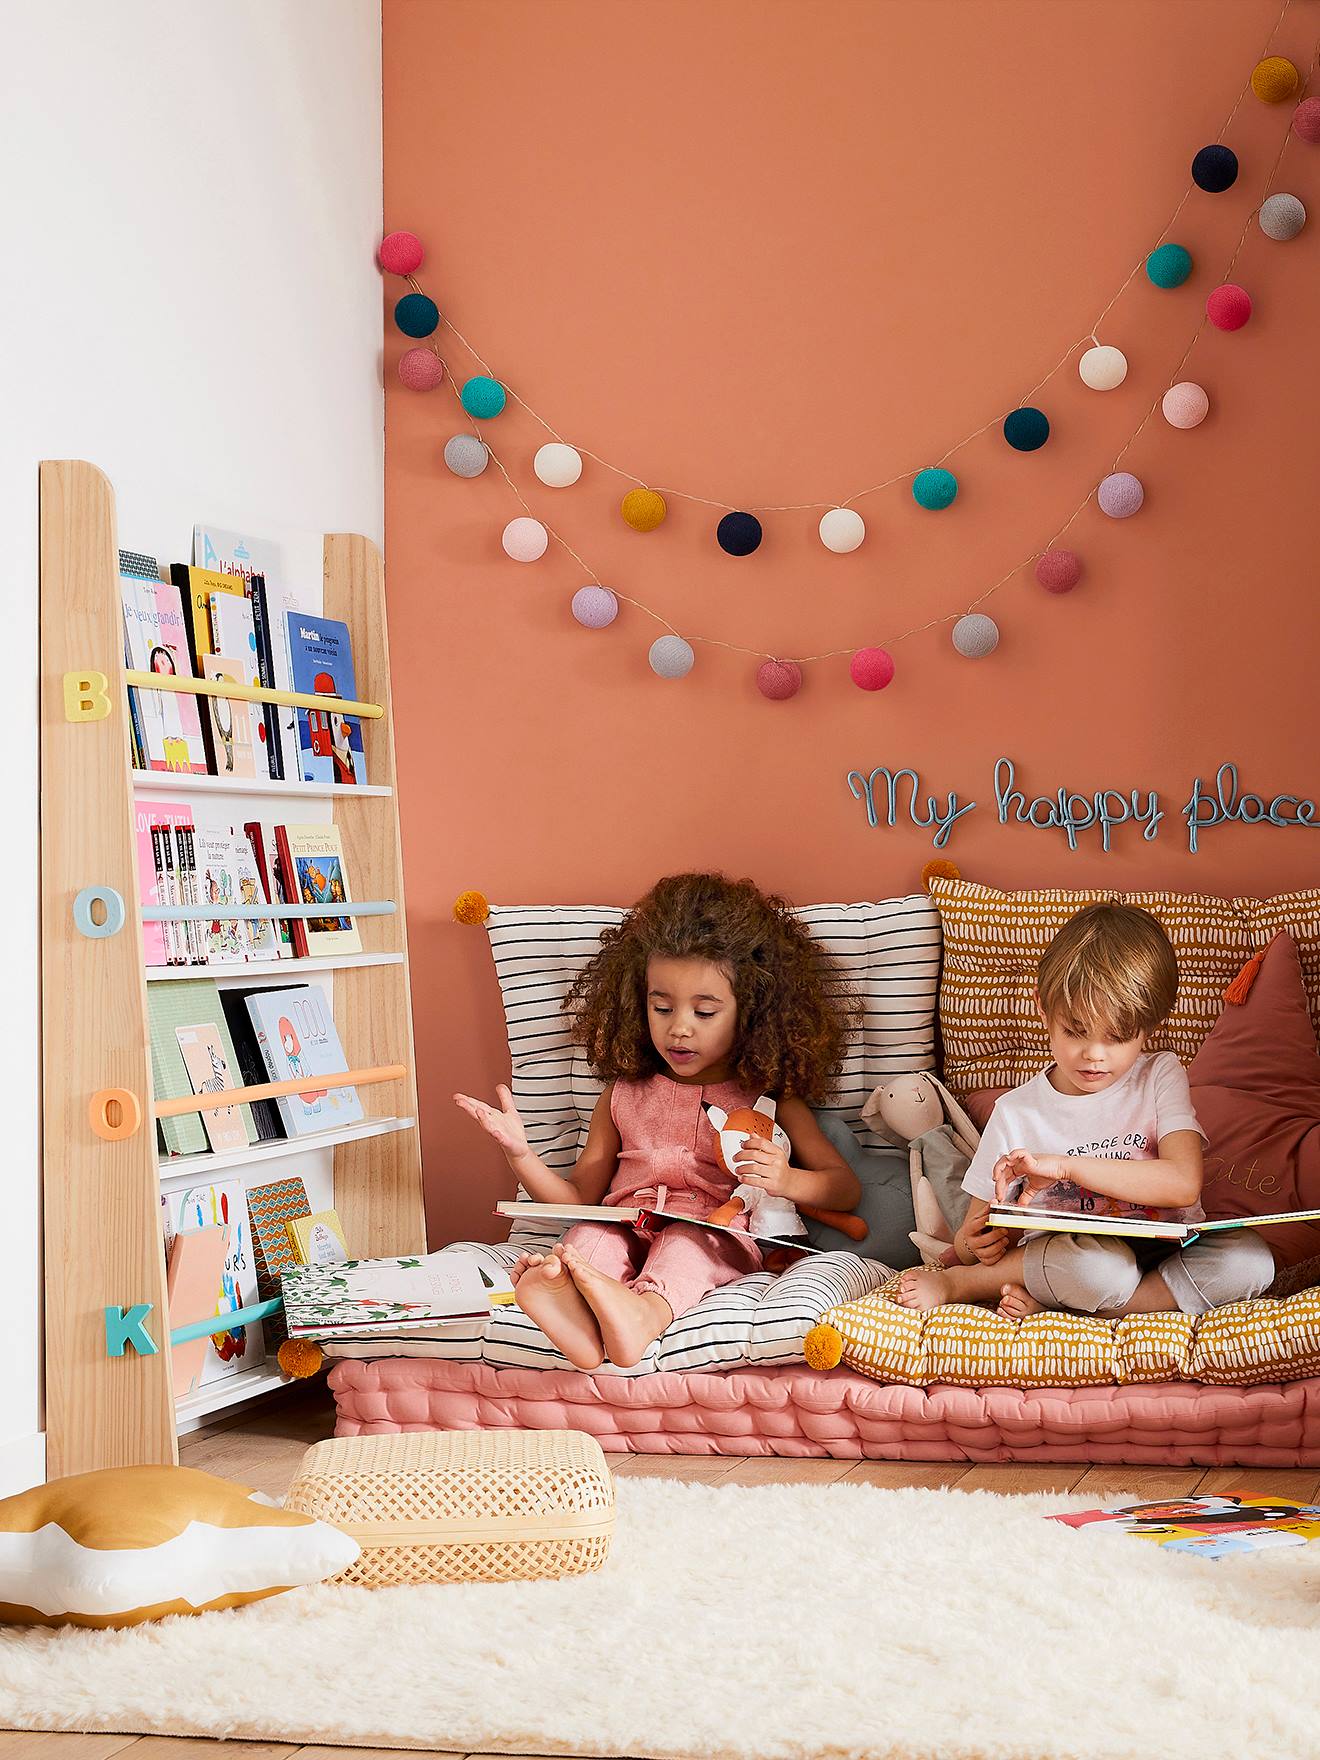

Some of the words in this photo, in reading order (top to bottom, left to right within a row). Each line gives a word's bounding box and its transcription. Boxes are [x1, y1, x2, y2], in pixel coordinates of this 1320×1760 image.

[134, 609, 152, 623] veux
[153, 610, 179, 627] grandir
[847, 765, 977, 850] My
[993, 757, 1165, 853] happy
[1181, 762, 1320, 854] place
